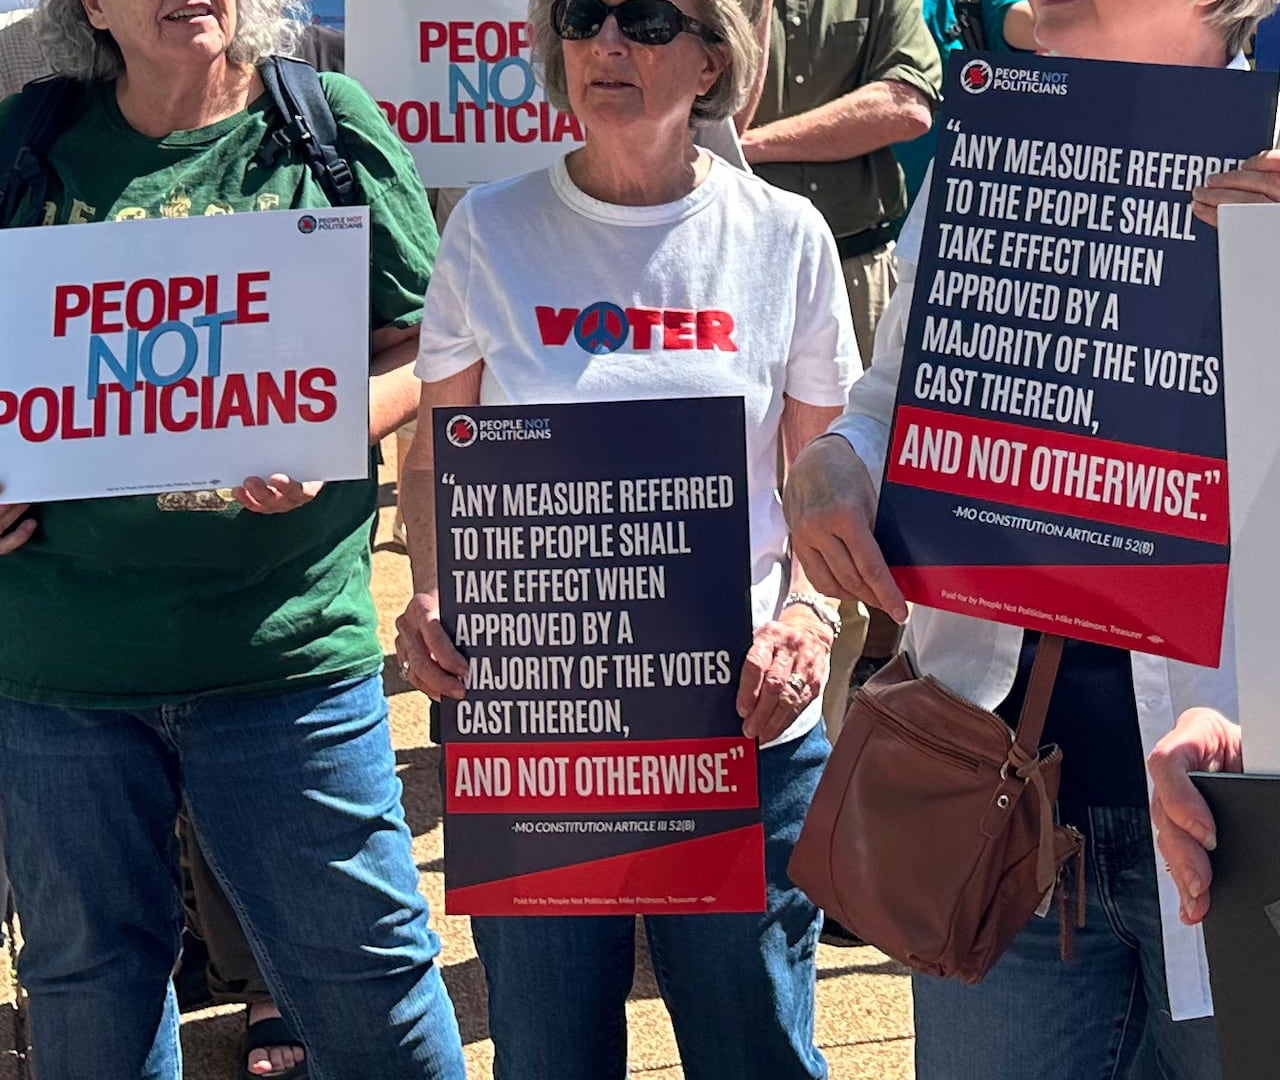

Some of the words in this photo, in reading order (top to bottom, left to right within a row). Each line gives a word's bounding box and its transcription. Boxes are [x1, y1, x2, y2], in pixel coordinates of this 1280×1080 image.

[993, 67, 1039, 81] PEOPLE
[1042, 71, 1068, 85] NOT
[993, 78, 1068, 96] POLITICIANS
[1004, 139, 1123, 184] MEASURE
[945, 178, 974, 215] TO
[978, 180, 1021, 219] THE
[1025, 188, 1116, 232] PEOPLE
[1119, 203, 1196, 242] SHALL
[937, 223, 996, 265] TAKE
[1001, 229, 1085, 274] EFFECT
[1088, 245, 1163, 288] WHEN
[53, 271, 271, 338] PEOPLE
[928, 269, 1058, 325] APPROVED
[1066, 288, 1099, 326] BY
[1101, 294, 1119, 331] A
[86, 310, 238, 400] NOT
[921, 314, 1051, 369] MAJORITY
[1055, 336, 1088, 376] OF
[1092, 341, 1137, 384] THE
[1141, 353, 1220, 397] VOTES
[914, 362, 977, 406] CAST
[980, 372, 1102, 436] THEREON,
[479, 419, 522, 432] PEOPLE
[523, 418, 550, 431] NOT
[479, 428, 552, 442] POLITICIANS
[898, 422, 963, 474] AND
[967, 433, 1028, 488] NOT
[502, 480, 614, 517] MEASURE
[619, 474, 734, 513] REFERRED
[450, 526, 479, 561] TO
[482, 525, 524, 560] THE
[529, 522, 614, 560] PEOPLE
[619, 520, 691, 556] SHALL
[978, 509, 1066, 537] CONSTITUTION
[1064, 525, 1111, 547] ARTICLE
[451, 569, 508, 604] TAKE
[513, 566, 593, 603] EFFECT
[595, 564, 666, 601] WHEN
[455, 611, 577, 648] APPROVED
[582, 610, 612, 646] BY
[615, 608, 634, 645] A
[463, 654, 576, 692] MAJORITY
[579, 653, 610, 689] OF
[613, 652, 656, 688] THE
[660, 650, 731, 687] VOTES
[456, 699, 514, 736] CAST
[518, 698, 630, 739] THEREON,
[454, 757, 514, 798] AND
[518, 754, 570, 797] NOT
[535, 822, 614, 832] CONSTITUTION
[614, 821, 655, 831] ARTICLE
